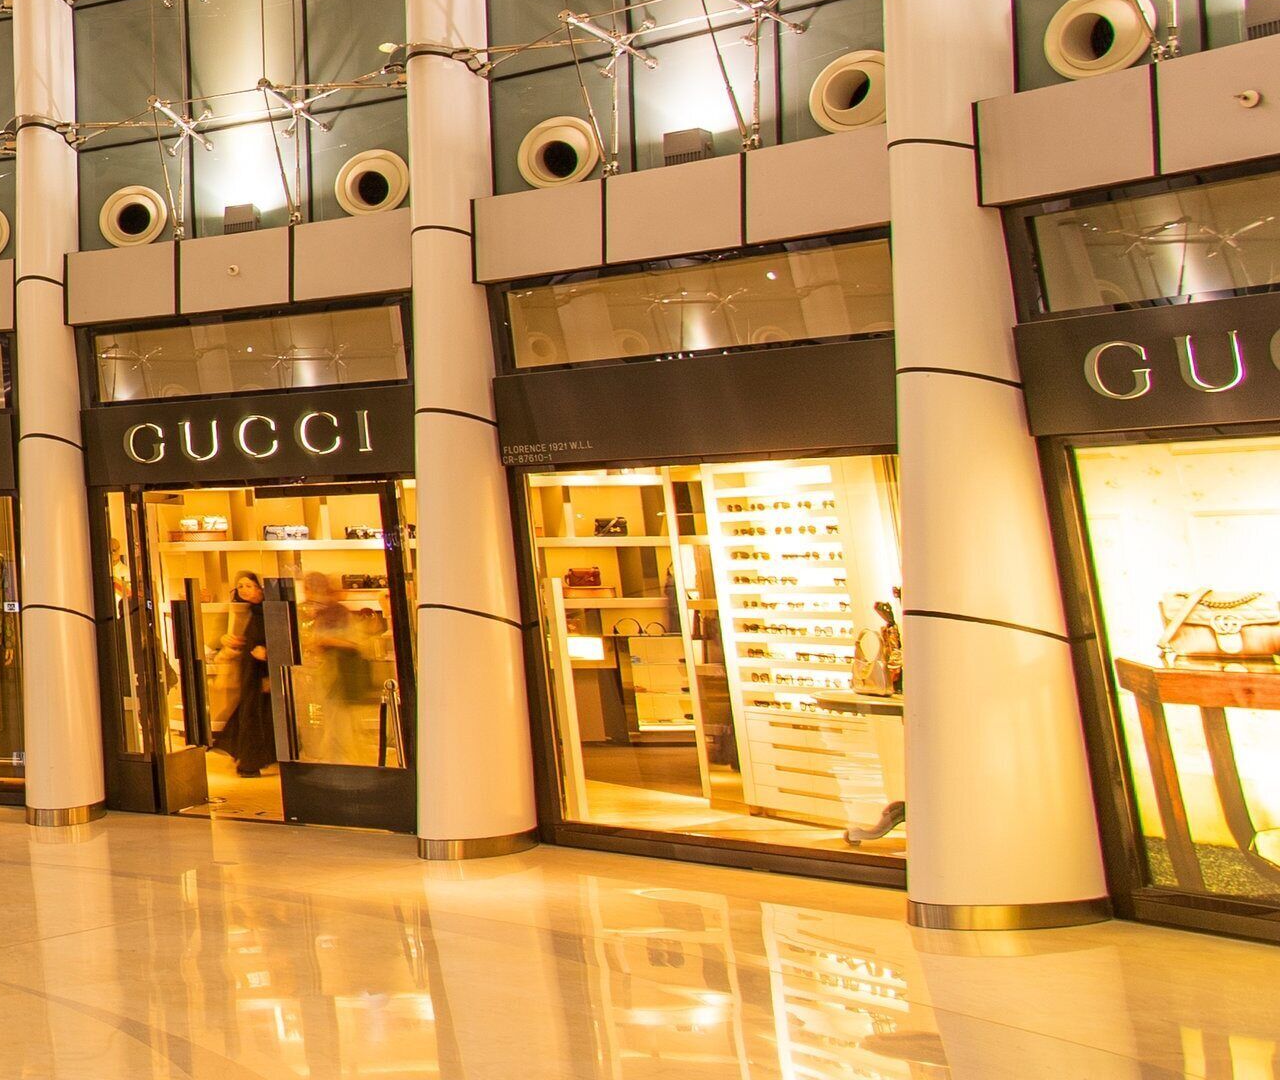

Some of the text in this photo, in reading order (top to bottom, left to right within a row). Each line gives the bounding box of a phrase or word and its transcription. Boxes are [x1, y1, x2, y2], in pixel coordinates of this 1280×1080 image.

[1083, 330, 1280, 400] GU
[123, 410, 373, 464] GUCCI
[503, 443, 547, 455] FLORENCE
[549, 442, 568, 452] 1921
